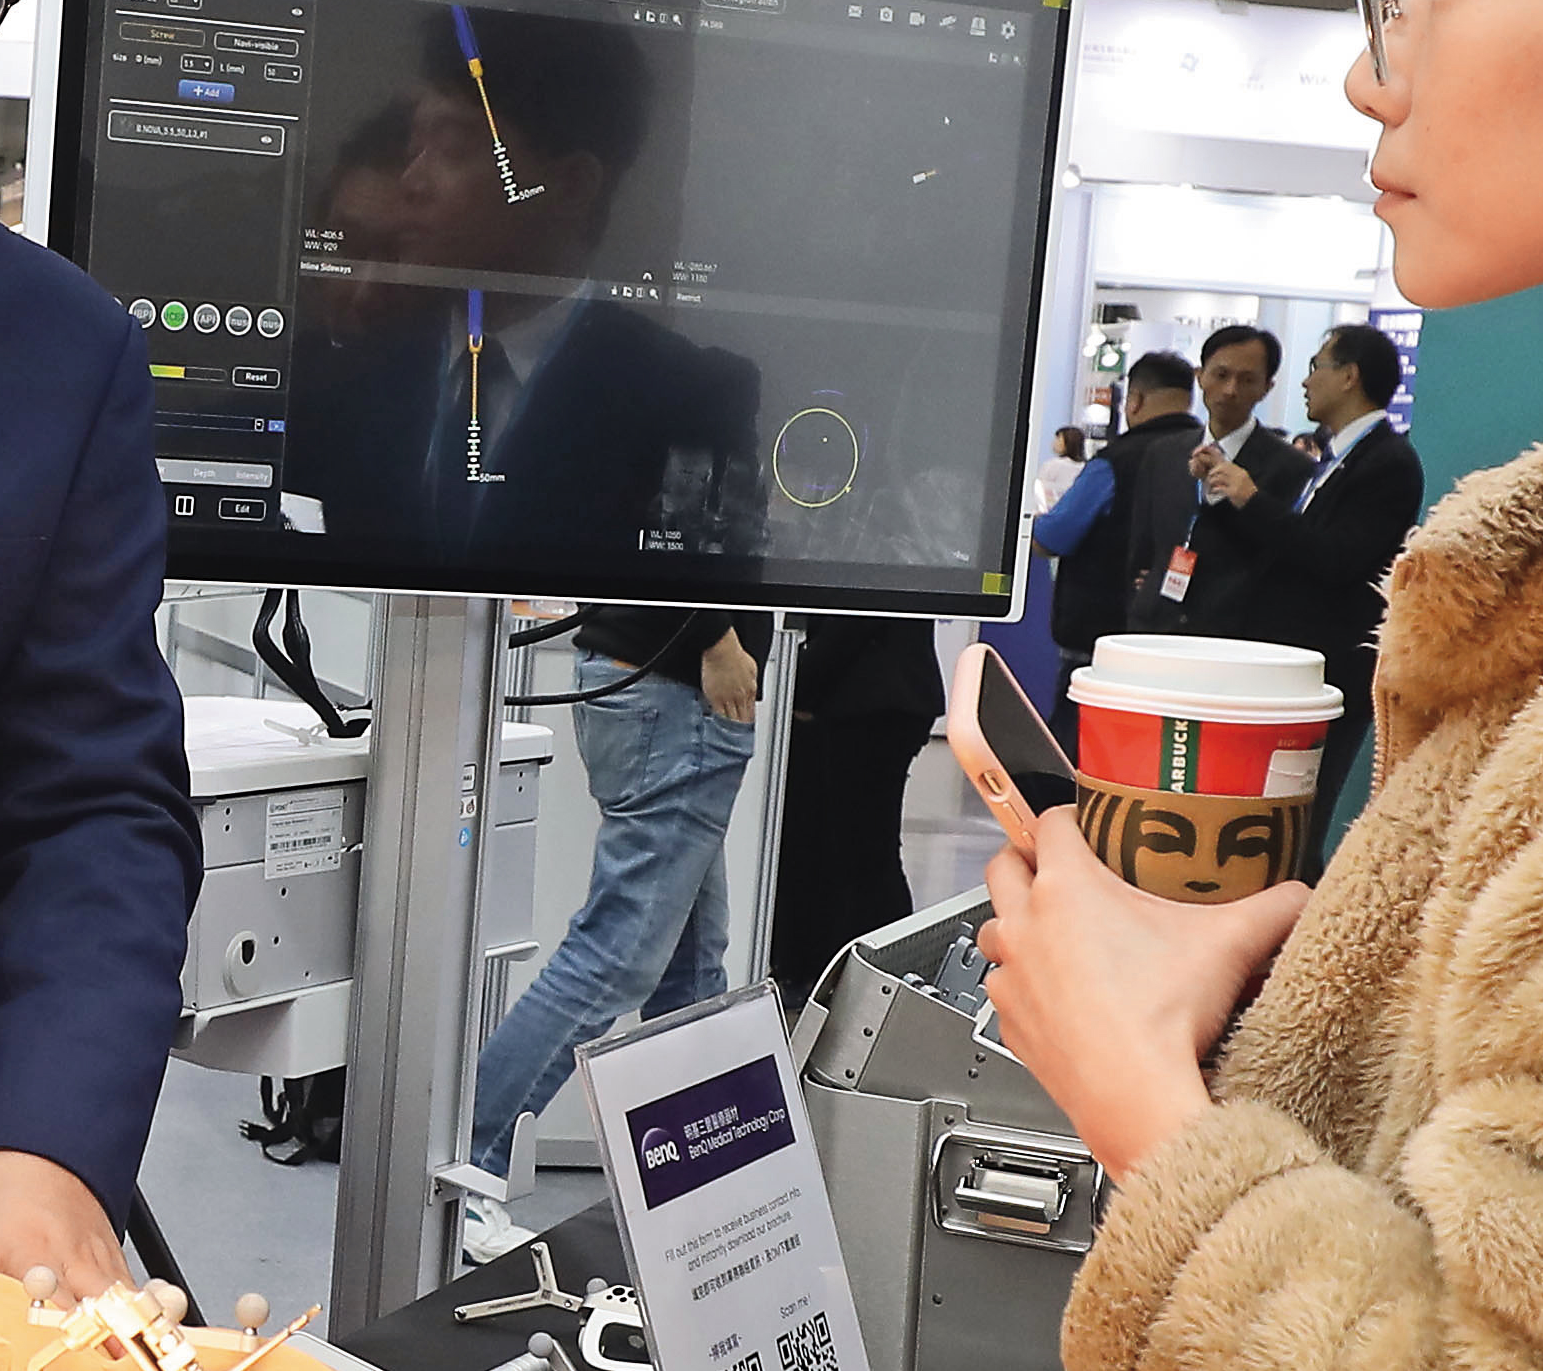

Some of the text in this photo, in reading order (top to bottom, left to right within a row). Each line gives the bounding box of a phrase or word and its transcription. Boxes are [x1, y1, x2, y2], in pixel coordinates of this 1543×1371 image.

[151, 29, 175, 40] Screw
[205, 88, 219, 98] Add
[519, 184, 546, 200] 50mm
[320, 263, 352, 275] Sideways
[245, 372, 267, 382] Reset
[193, 468, 216, 478] Depth
[479, 473, 506, 483] 50mm
[235, 504, 250, 514] Edit
[688, 1141, 709, 1160] BenQ
[708, 1132, 735, 1153] Medical
[733, 1116, 770, 1142] Technology
[779, 1300, 798, 1319] Scan
